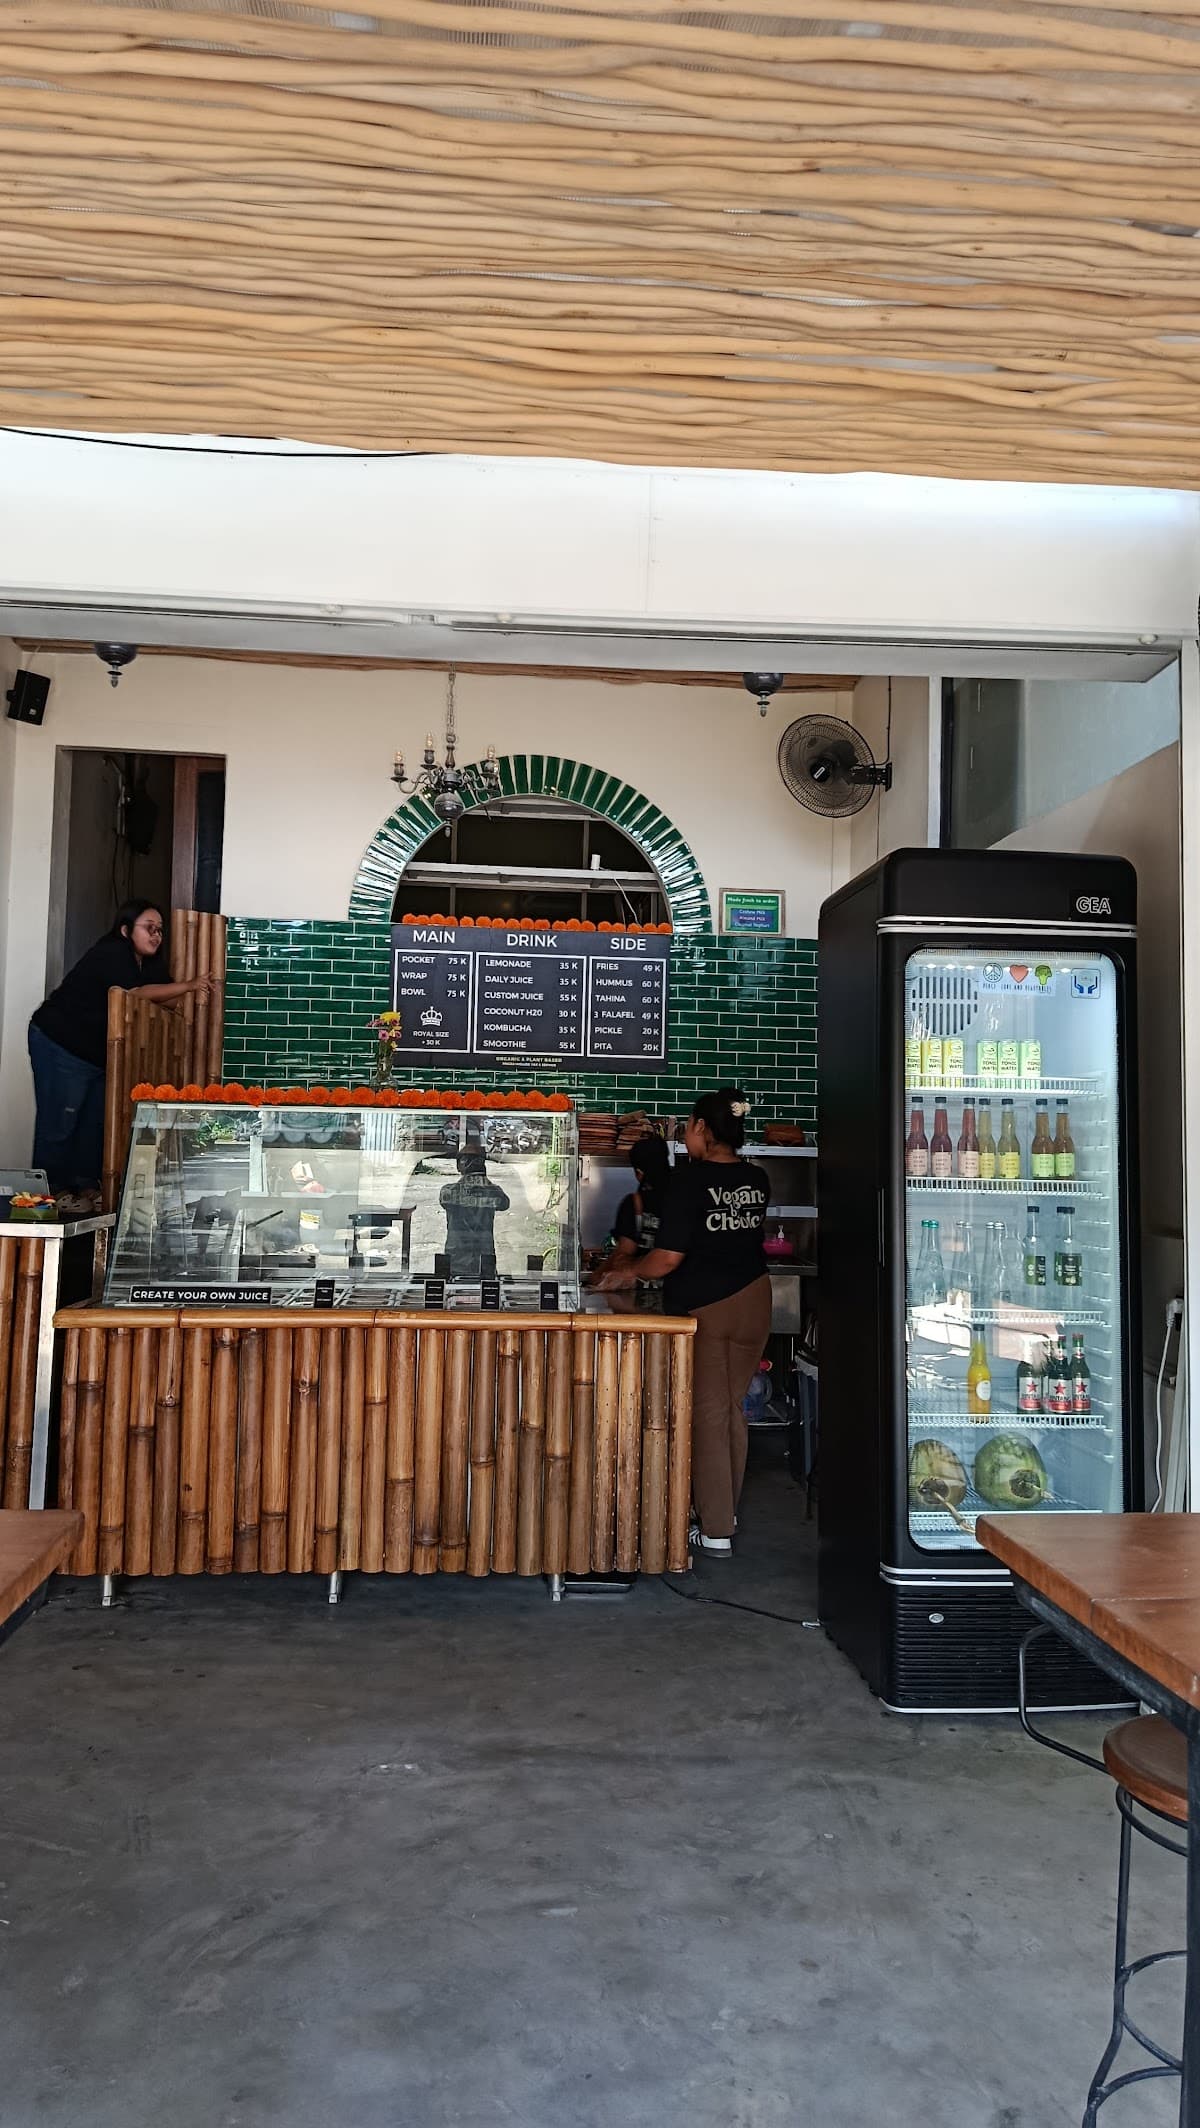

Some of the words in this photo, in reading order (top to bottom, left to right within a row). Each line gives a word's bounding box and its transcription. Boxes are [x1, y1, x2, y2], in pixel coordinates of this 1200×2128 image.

[1076, 896, 1112, 915] GEA
[413, 930, 456, 944] MAIN
[506, 933, 558, 948] DRINK
[610, 937, 647, 951] SIDE
[401, 956, 436, 964] POCKET
[448, 957, 458, 965] 75
[485, 959, 532, 968] LEMONADE
[559, 962, 569, 970] 35
[571, 962, 578, 970] K
[596, 962, 619, 971] FRIES
[642, 964, 653, 972] 49
[447, 974, 457, 982] 75
[460, 974, 466, 982] K
[484, 975, 509, 983] DAILY
[509, 976, 534, 984] JUICE
[559, 978, 569, 986] 35
[595, 979, 633, 987] HUMMUS
[642, 980, 652, 988] 60
[401, 988, 426, 996] BOWL
[447, 990, 457, 998] 75
[459, 990, 466, 998] K
[484, 992, 519, 1000] CUSTOM
[520, 993, 544, 1001] JUICE
[559, 994, 569, 1002] 55
[595, 994, 626, 1003] TAHINA
[642, 996, 652, 1004] 60
[654, 996, 660, 1004] K
[483, 1008, 526, 1016] COCONUT
[558, 1010, 568, 1018] 30
[570, 1010, 577, 1018] K
[593, 1011, 599, 1019] 3
[601, 1011, 636, 1019] FALAFEL
[641, 1012, 651, 1020] 49
[654, 1012, 660, 1020] K
[483, 1023, 532, 1032] KOMBUCHA
[558, 1026, 568, 1034] 35
[570, 1026, 576, 1034] K
[594, 1026, 623, 1034] PICKLE
[642, 1027, 652, 1035] 20
[483, 1039, 527, 1048] SMOOTHIE
[594, 1042, 613, 1050] PITA
[642, 1043, 652, 1051] 20
[707, 1185, 766, 1210] Vegan
[133, 1290, 175, 1299] CREATE
[177, 1291, 207, 1300] YOUR
[210, 1291, 236, 1300] OWN
[238, 1291, 269, 1301] JUICE
